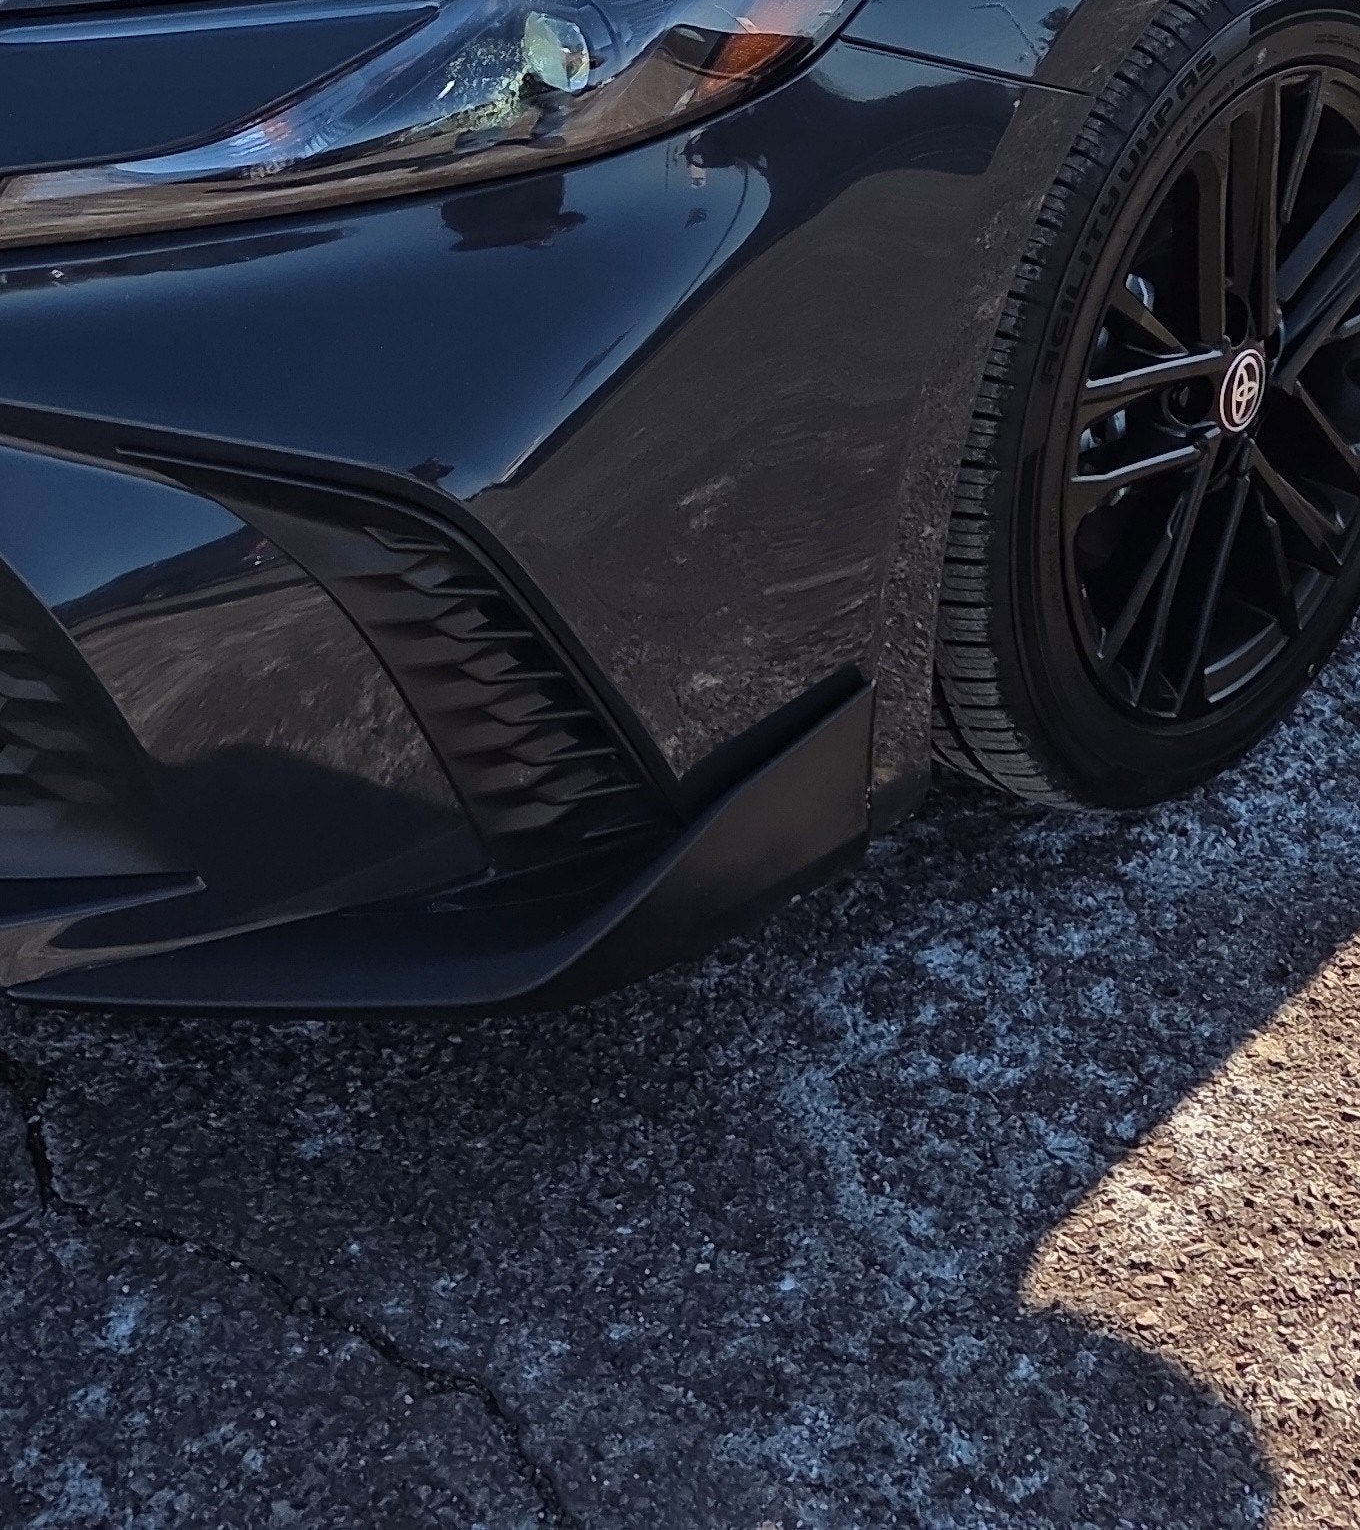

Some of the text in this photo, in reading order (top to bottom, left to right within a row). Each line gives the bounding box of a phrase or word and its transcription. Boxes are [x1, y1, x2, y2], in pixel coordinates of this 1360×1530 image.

[1040, 186, 1121, 384] AGILITY
[1118, 96, 1174, 183] UHP
[1175, 50, 1218, 101] AS
